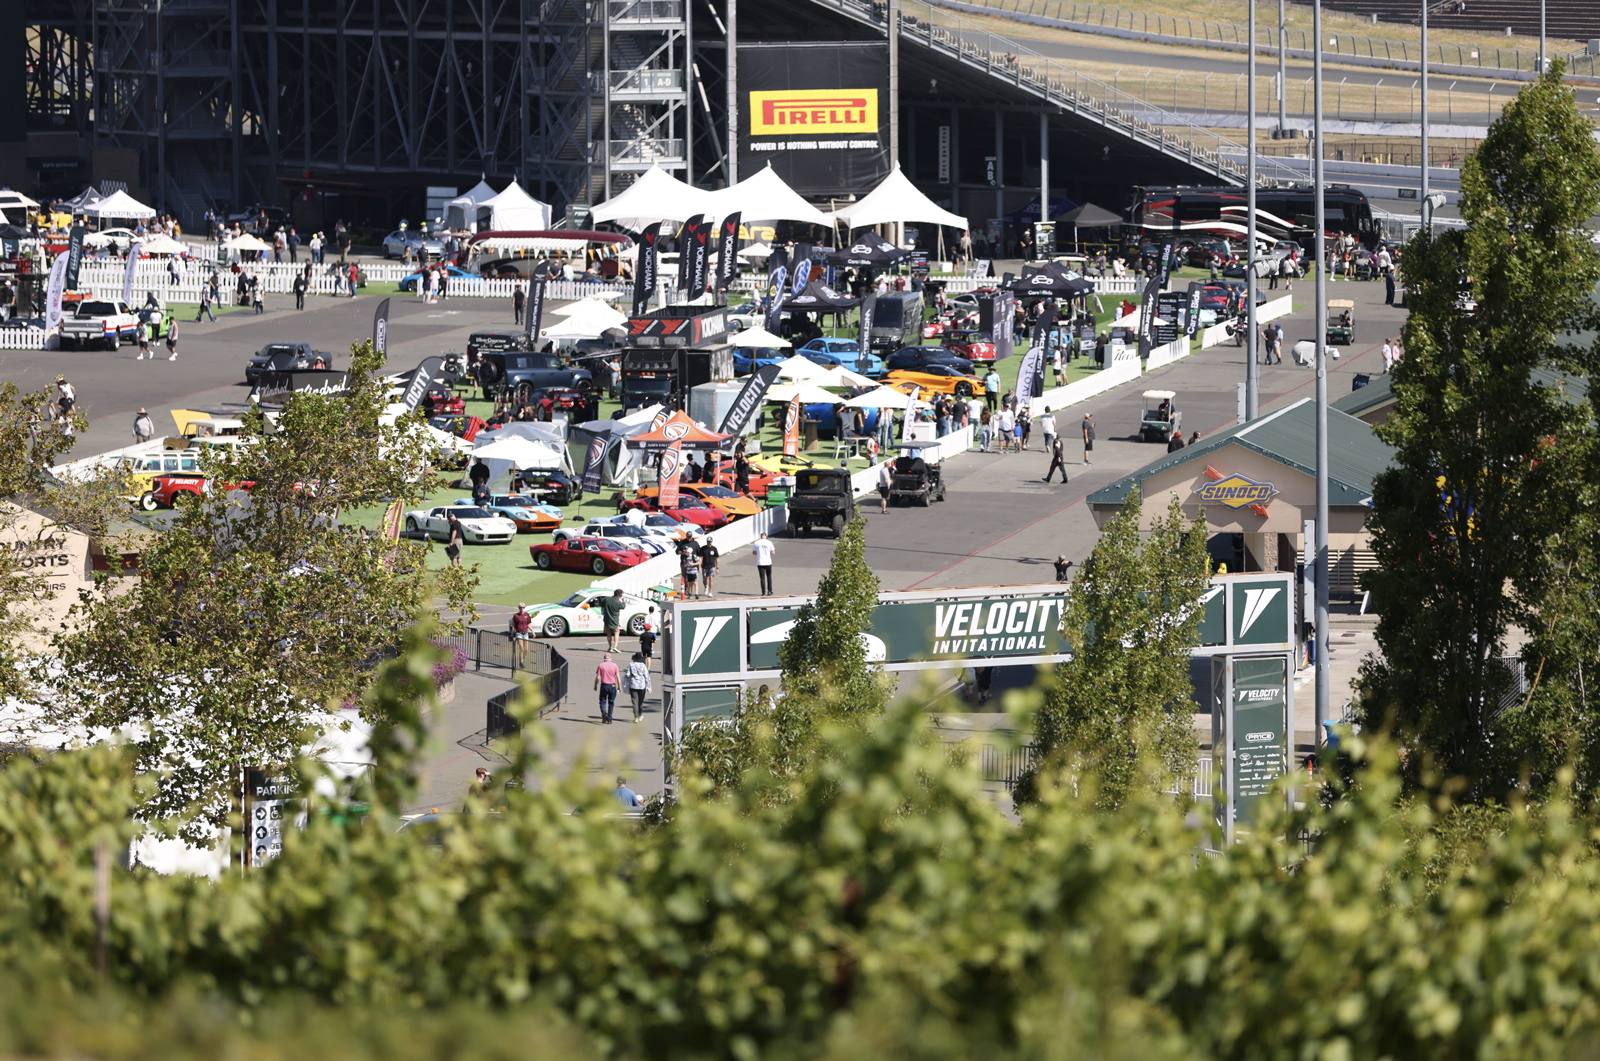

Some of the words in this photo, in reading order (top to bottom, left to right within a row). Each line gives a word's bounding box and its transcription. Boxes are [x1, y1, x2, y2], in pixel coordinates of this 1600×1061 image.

[762, 98, 867, 125] PIRELLI
[750, 142, 777, 151] POWER
[778, 142, 786, 150] IS
[786, 140, 817, 150] NOTHING
[818, 140, 848, 149] WITHOUT
[849, 139, 879, 149] CONTROL
[986, 161, 994, 170] A
[987, 171, 994, 181] B
[69, 236, 79, 270] VELOCITY
[695, 246, 704, 290] YOKOHAMA
[724, 234, 734, 278] YOKOHAMA
[1159, 244, 1171, 284] Cars&Bids
[644, 246, 653, 291] YOKOHAMA
[1187, 290, 1200, 335] Cars&Bids
[405, 366, 431, 412] LOCITY
[1021, 354, 1036, 405] PIVOTAL
[726, 373, 767, 431] VELOCITY
[174, 478, 200, 486] VELOCITY
[1203, 487, 1270, 499] SUNOCO
[21, 553, 70, 569] ORTS
[932, 635, 1047, 655] INVITATIONAL
[1248, 688, 1280, 698] VELOCITY
